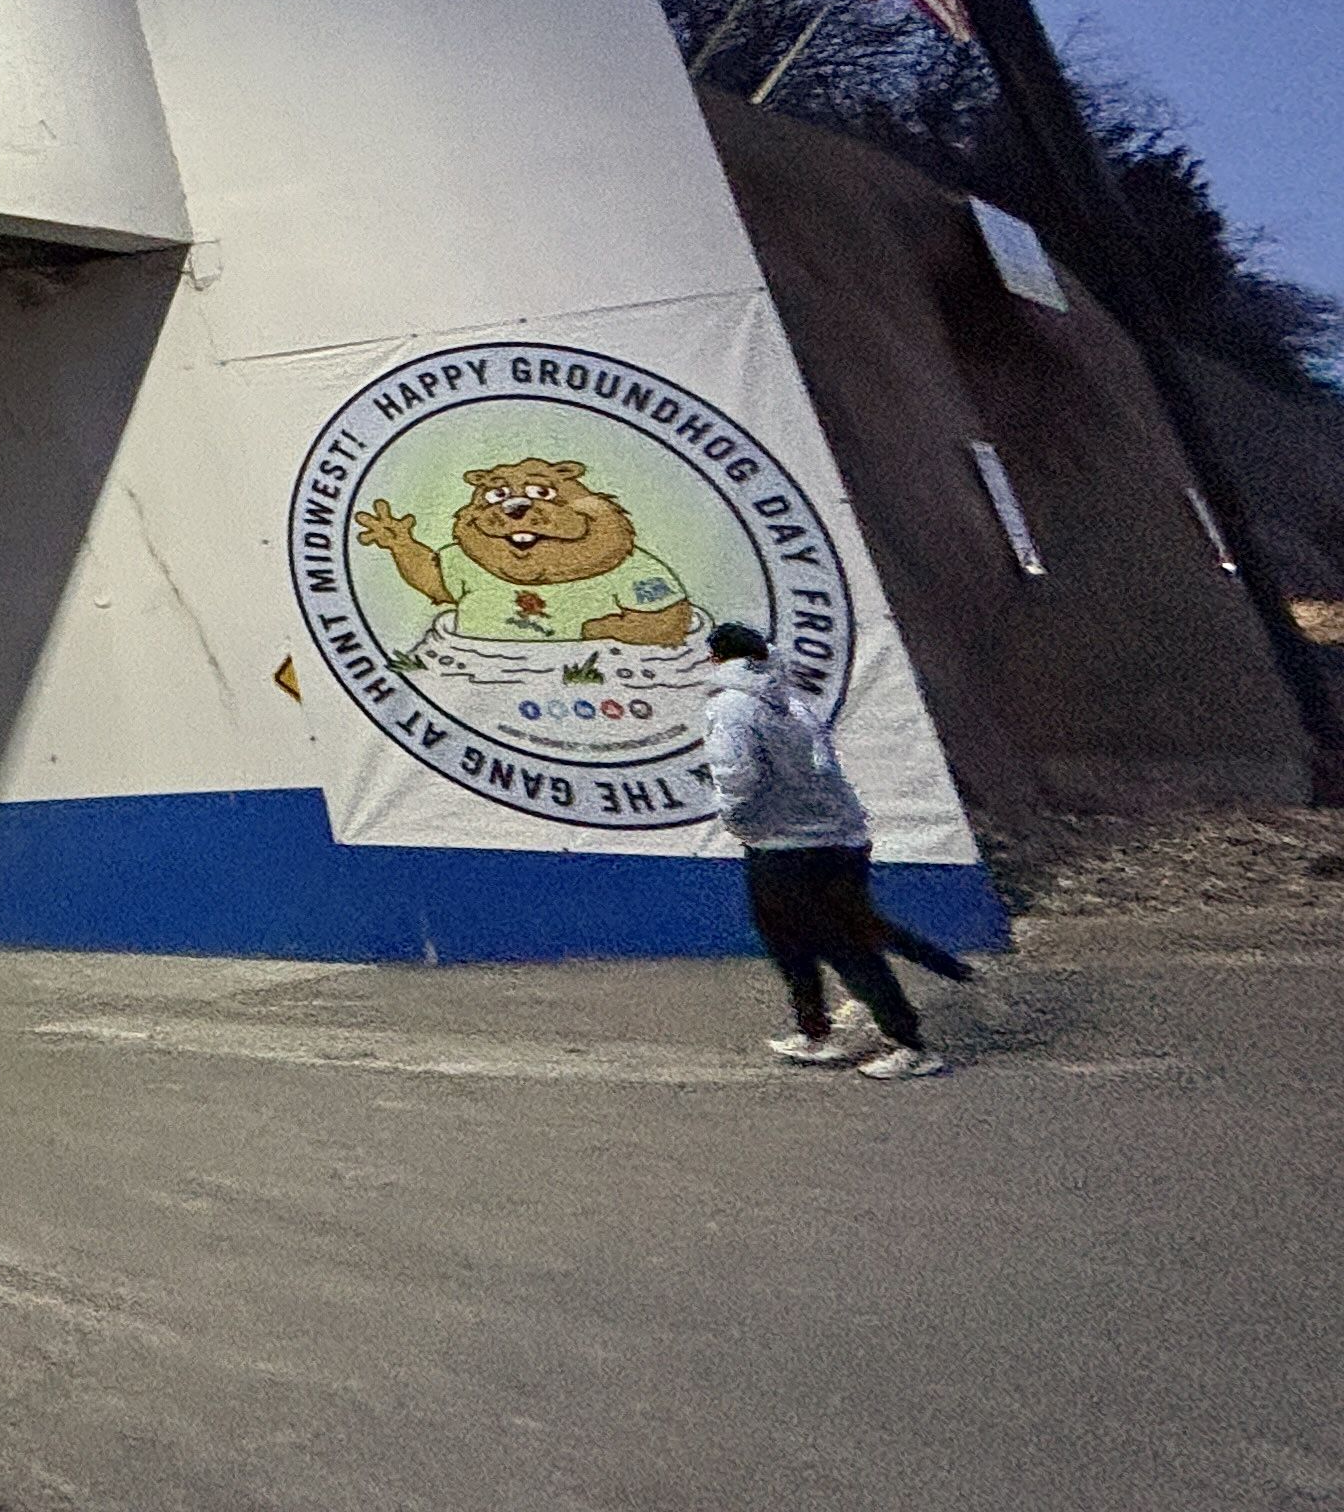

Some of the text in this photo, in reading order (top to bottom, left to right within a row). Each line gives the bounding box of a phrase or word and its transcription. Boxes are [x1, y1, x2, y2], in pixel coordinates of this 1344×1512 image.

[373, 358, 490, 422] HAPPY
[511, 357, 759, 484] GROUNDHOG
[305, 428, 367, 595] MIDWEST!
[754, 494, 822, 569] DAY
[319, 612, 393, 705] HUNT
[791, 588, 835, 698] FROM
[398, 709, 448, 744] AT
[461, 748, 577, 808] GANG
[602, 775, 683, 816] THE
